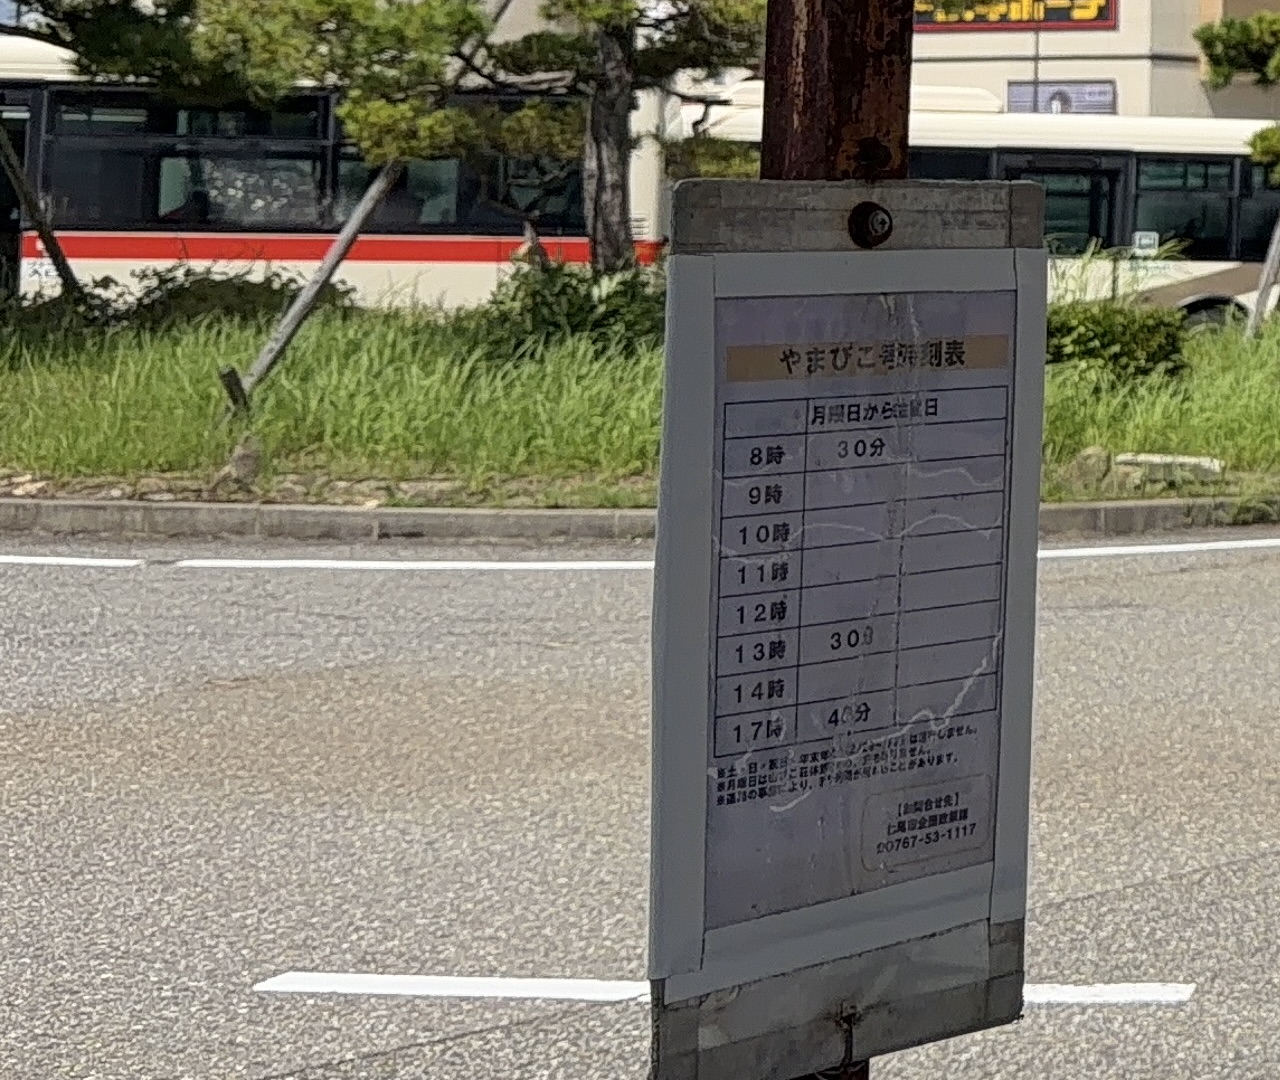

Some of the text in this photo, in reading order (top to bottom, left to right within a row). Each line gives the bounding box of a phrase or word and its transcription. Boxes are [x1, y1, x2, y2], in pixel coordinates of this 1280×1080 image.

[750, 445, 785, 465] 8時
[837, 438, 886, 459] 30分
[749, 483, 783, 505] 9時
[739, 522, 790, 545] 10時
[738, 562, 789, 585] 11時
[736, 600, 787, 624] 12時
[735, 639, 786, 663] 13時
[734, 678, 785, 703] 14時
